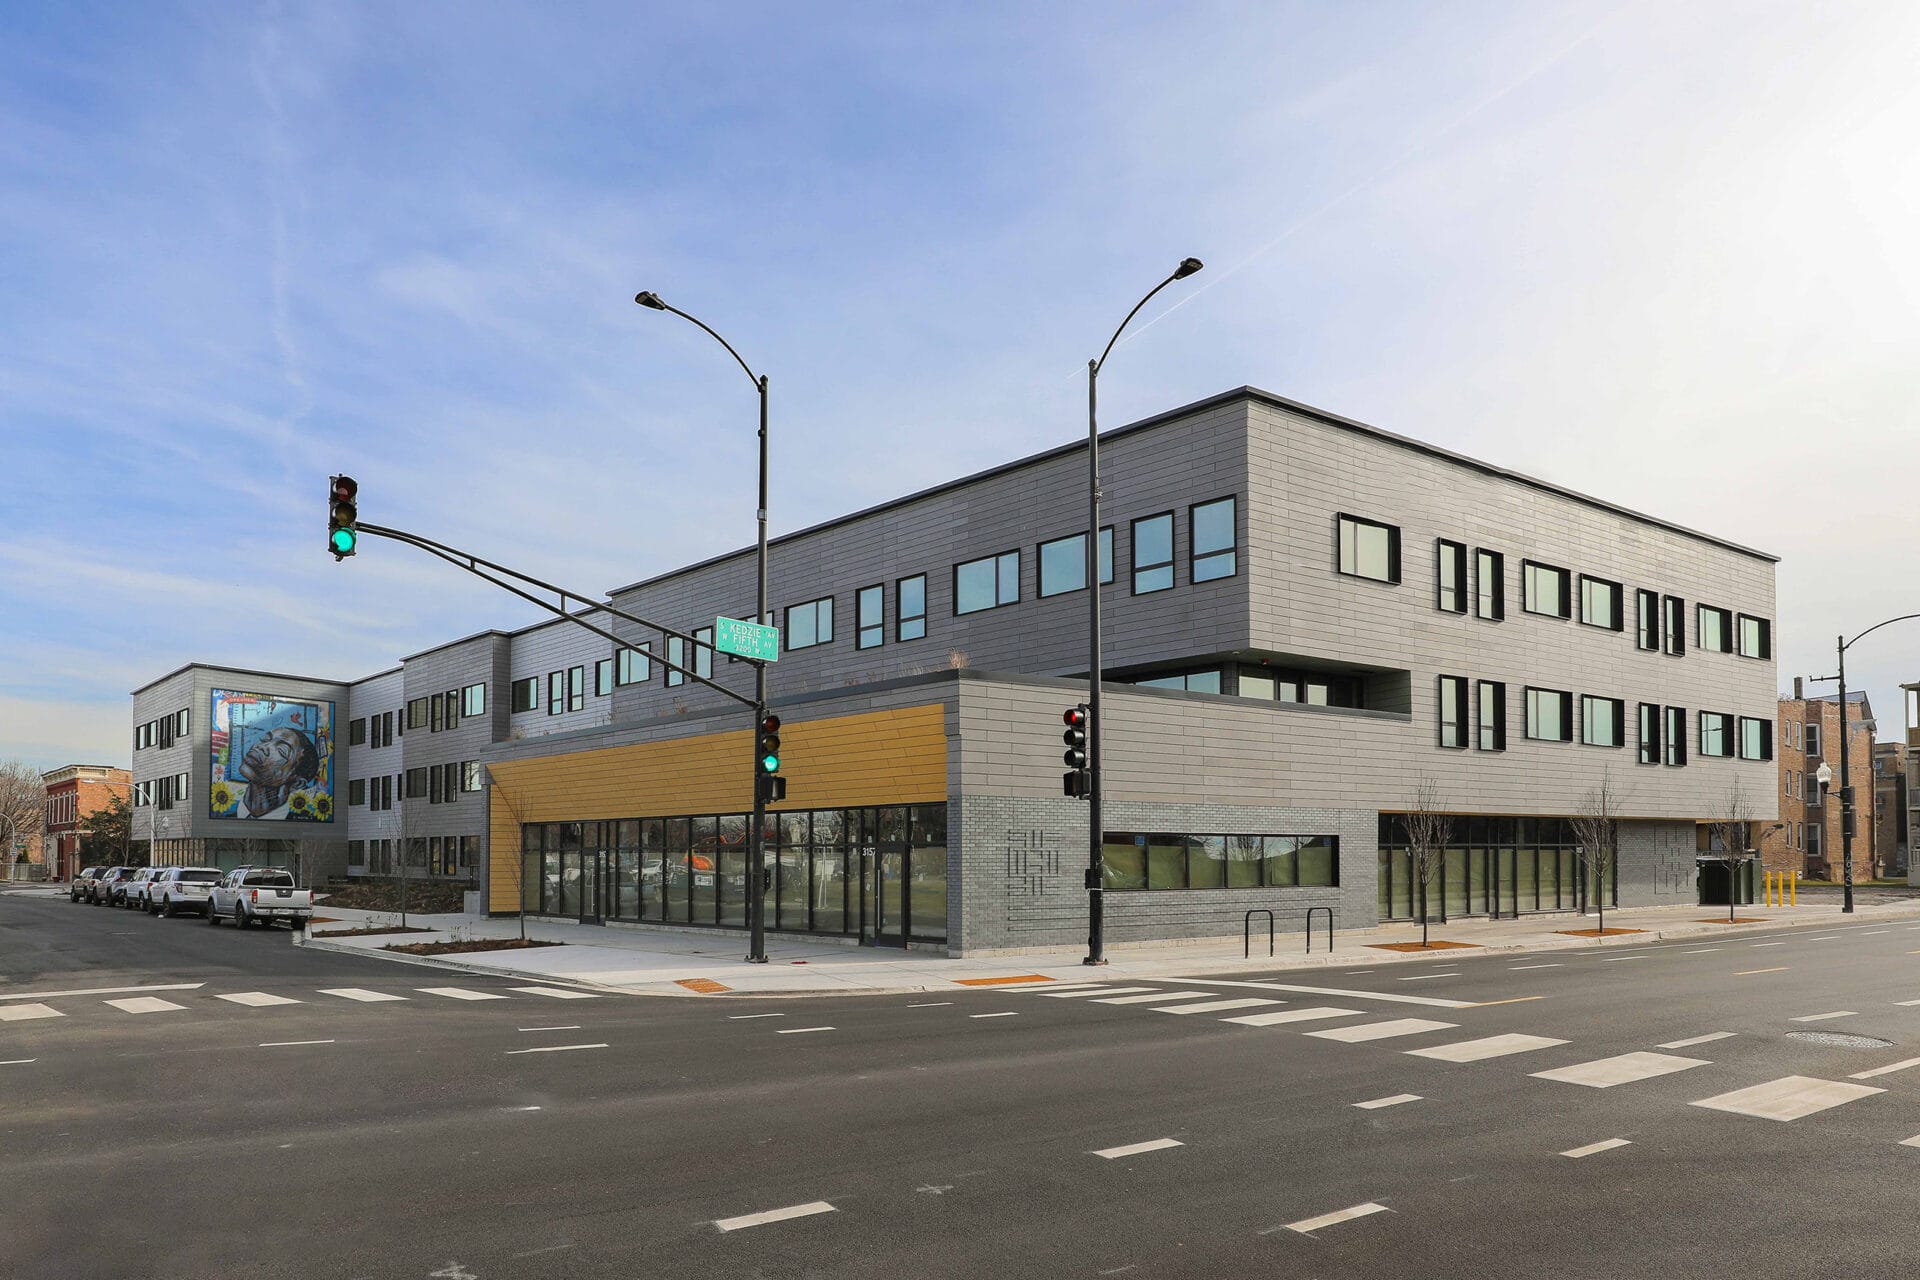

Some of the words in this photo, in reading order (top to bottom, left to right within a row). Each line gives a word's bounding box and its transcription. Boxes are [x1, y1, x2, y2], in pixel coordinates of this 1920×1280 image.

[720, 622, 725, 630] S
[730, 623, 761, 637] KEDZIE
[733, 634, 758, 647] FIFTH
[862, 847, 875, 856] 3157
